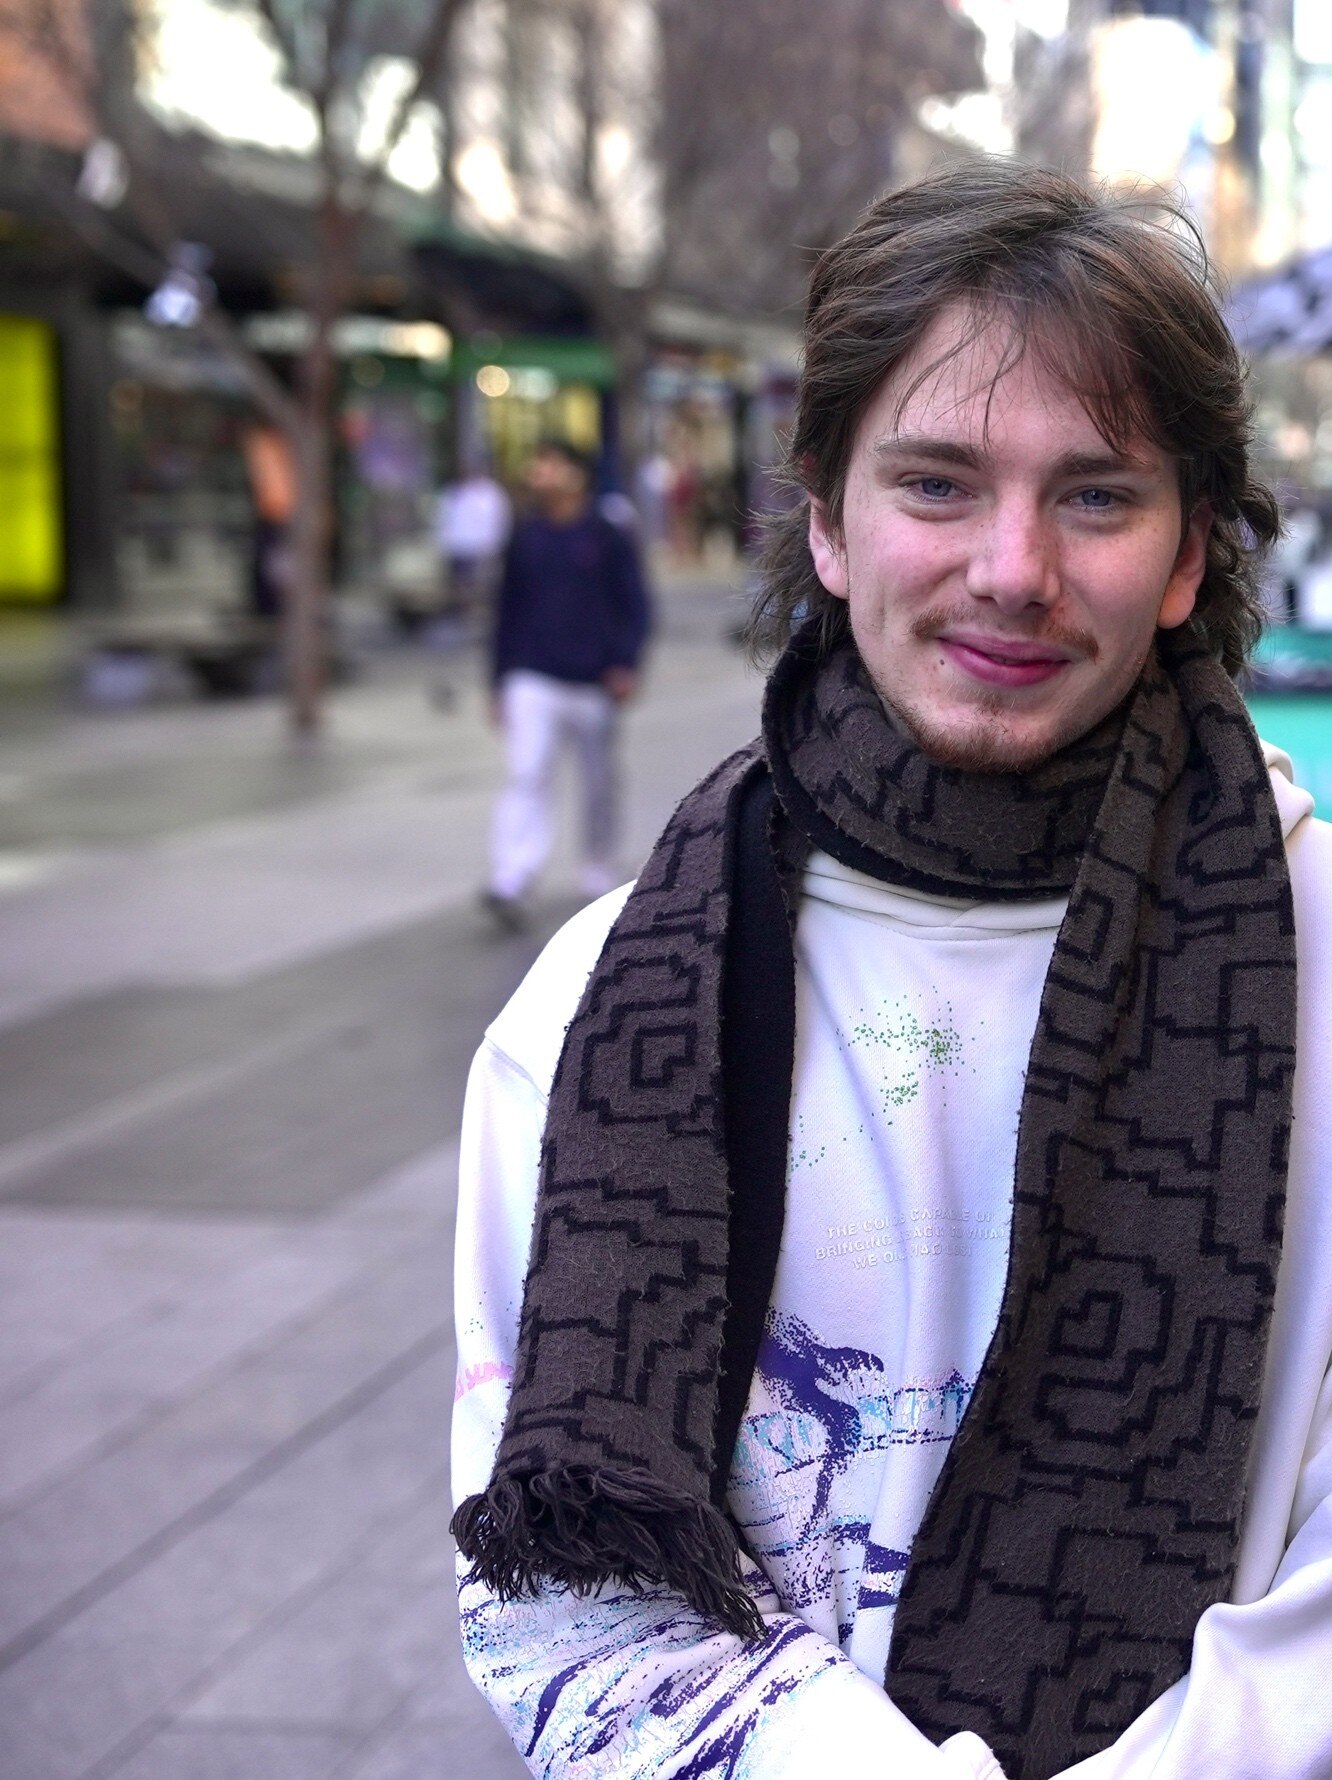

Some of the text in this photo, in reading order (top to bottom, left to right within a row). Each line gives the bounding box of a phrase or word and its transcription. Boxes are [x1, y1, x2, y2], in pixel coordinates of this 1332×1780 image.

[827, 1222, 857, 1239] THE
[815, 1234, 893, 1261] BRINGING
[852, 1253, 878, 1270] WE
